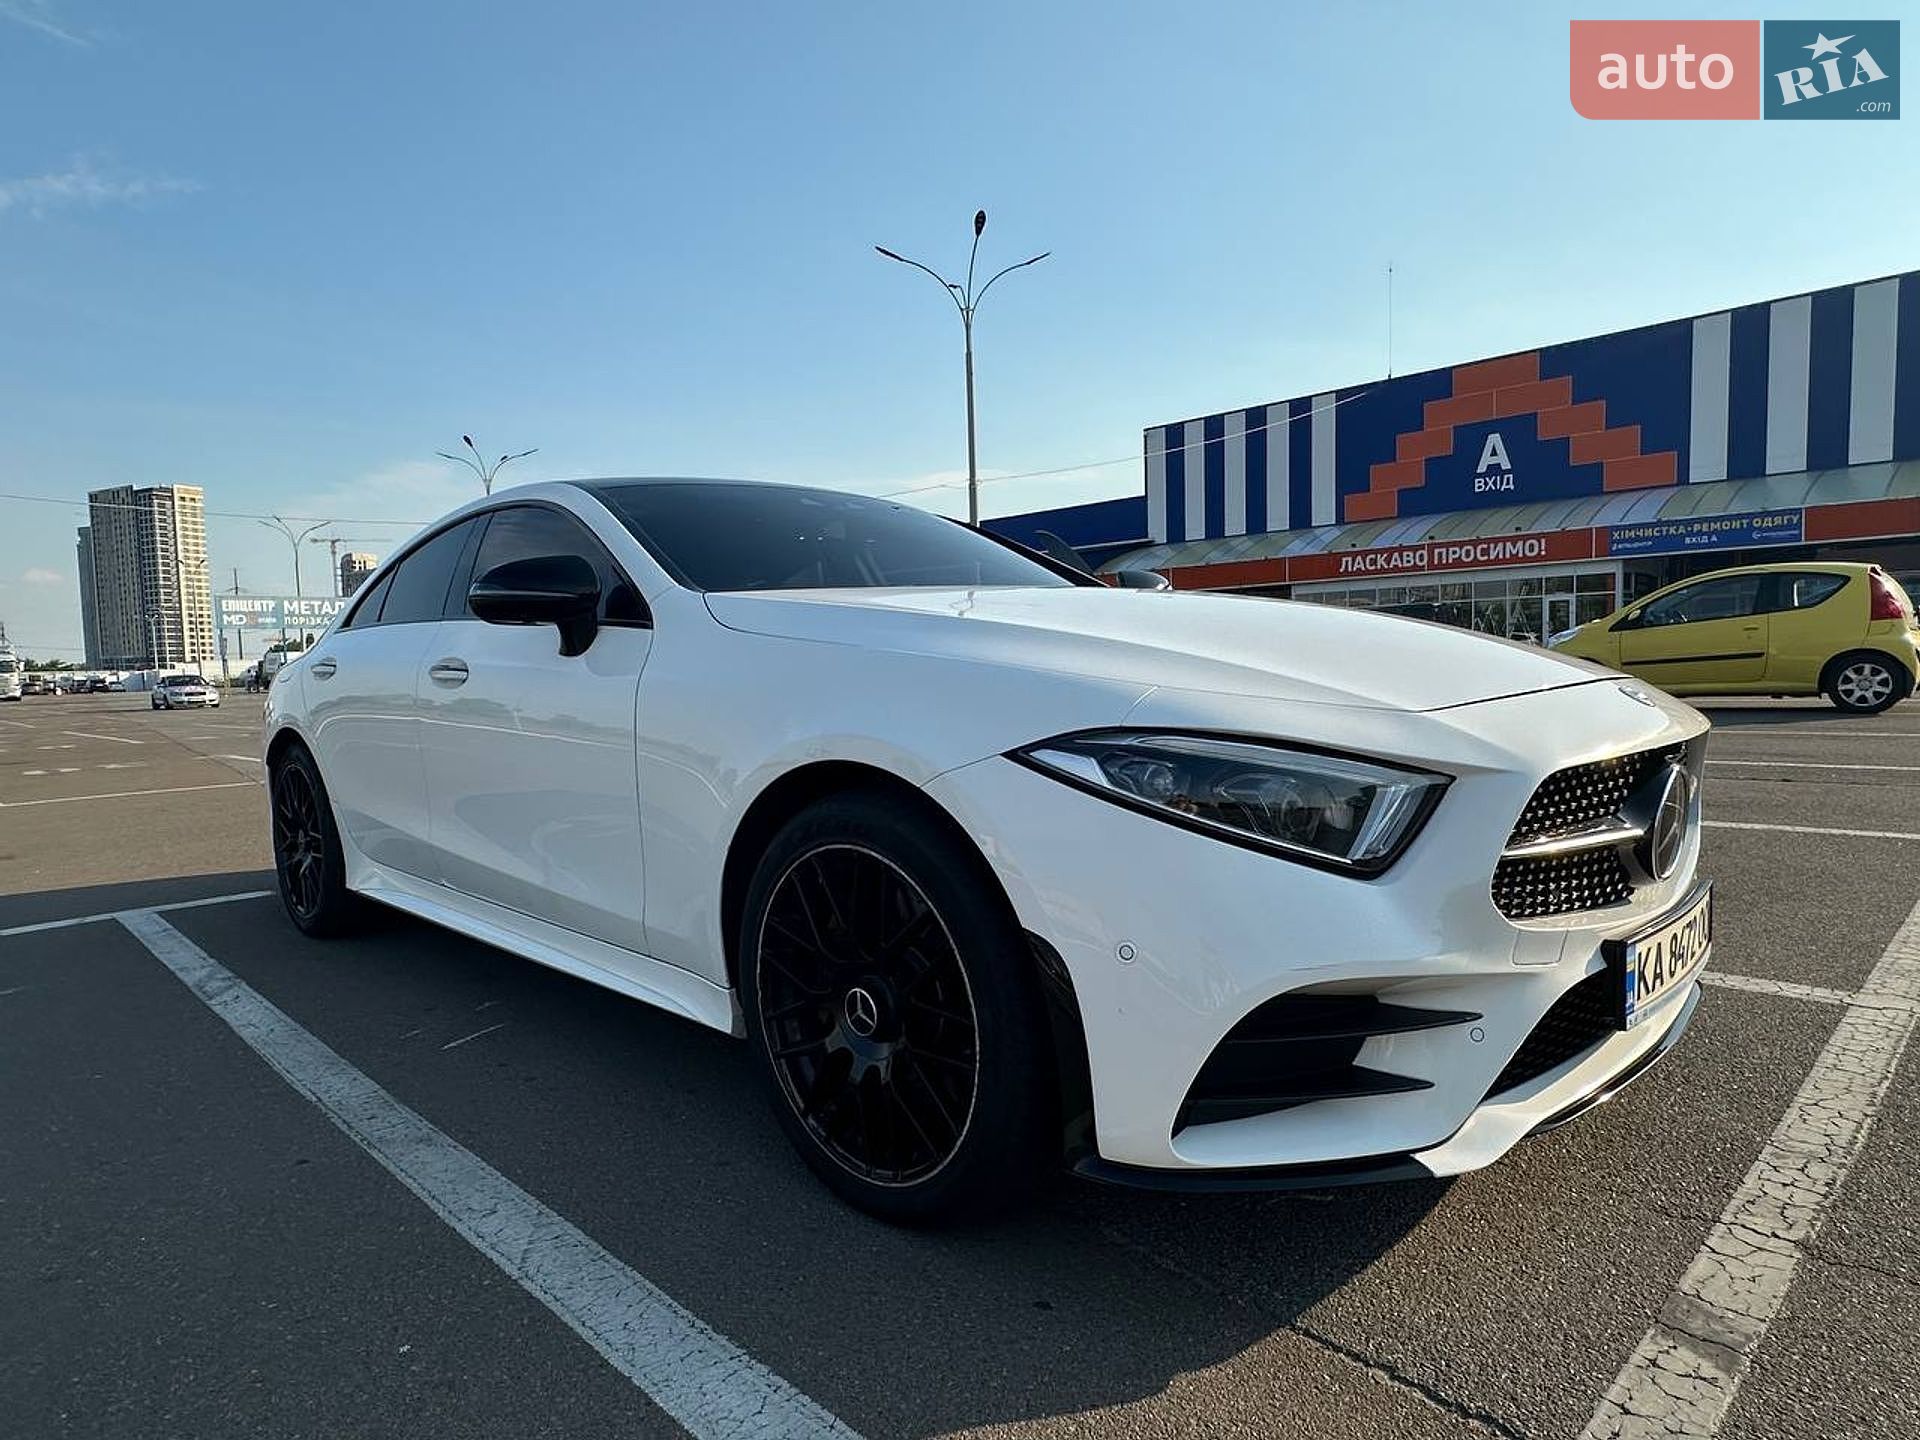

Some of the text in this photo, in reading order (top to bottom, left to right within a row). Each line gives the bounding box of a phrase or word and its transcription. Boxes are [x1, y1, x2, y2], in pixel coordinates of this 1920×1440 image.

[1476, 433, 1512, 473] А
[1474, 473, 1514, 493] ВХІД
[1752, 514, 1799, 527] ОДЯГУ
[1339, 538, 1546, 573] ЛАСКАВО ПРОСИМО!
[1637, 941, 1665, 1001] KA
[1668, 916, 1698, 979] 8472
